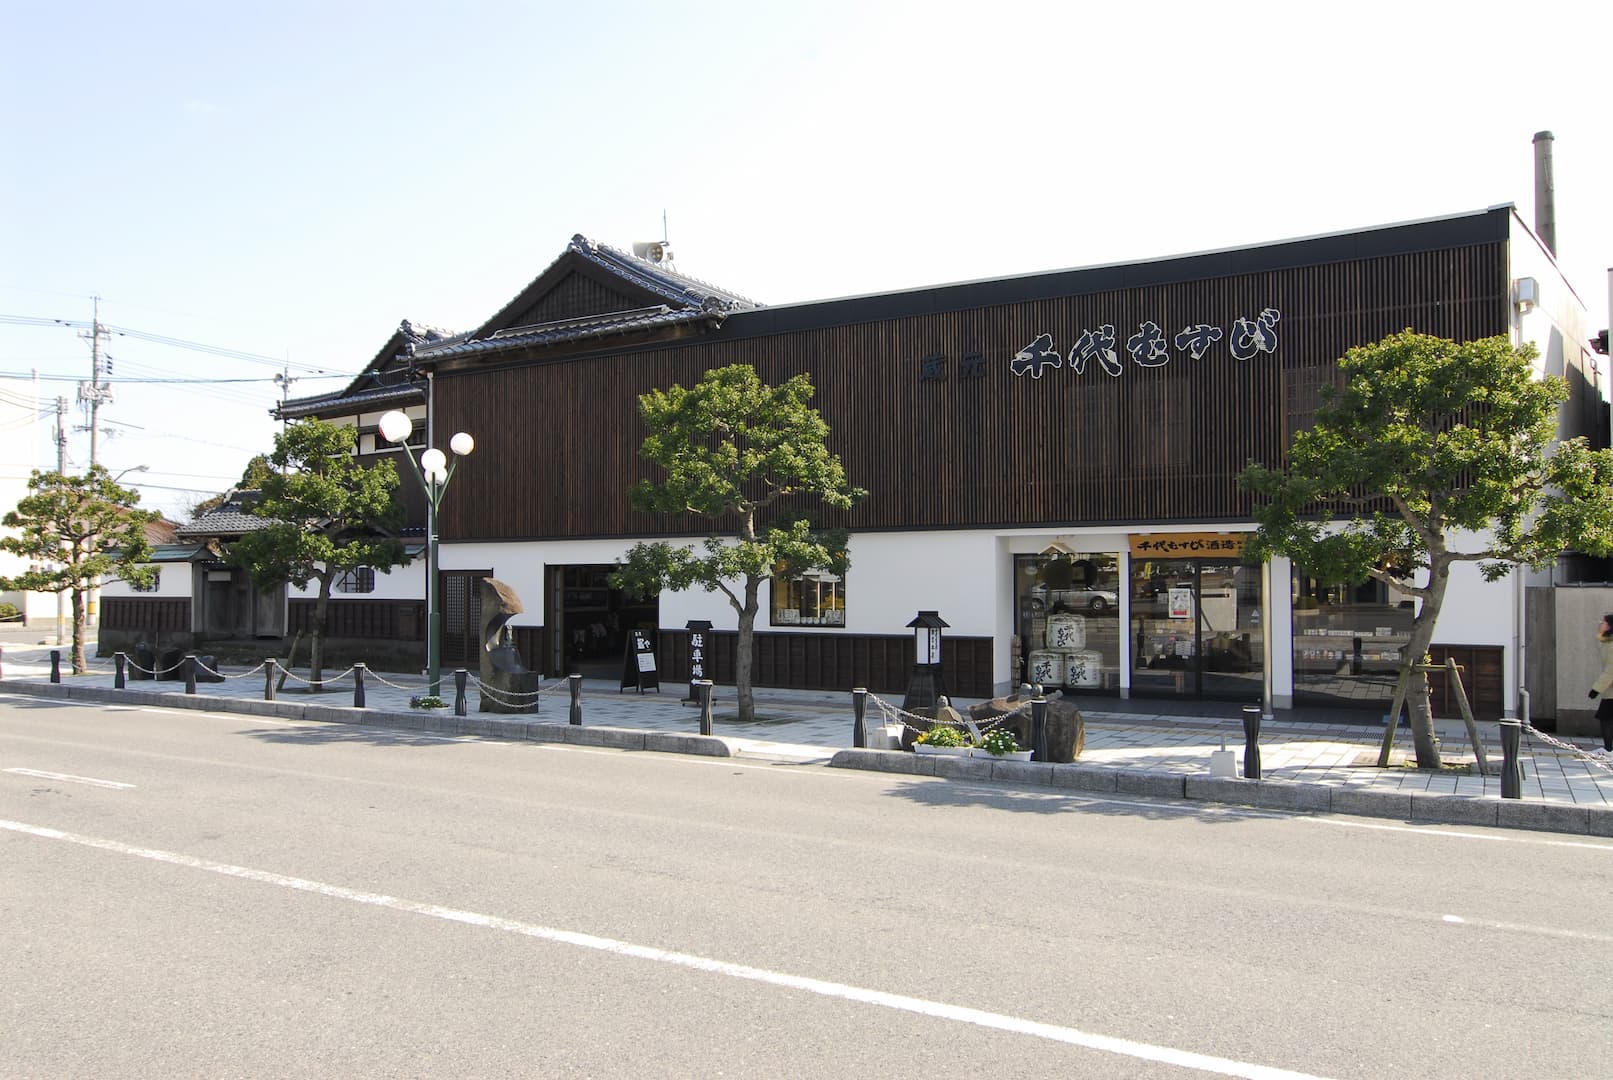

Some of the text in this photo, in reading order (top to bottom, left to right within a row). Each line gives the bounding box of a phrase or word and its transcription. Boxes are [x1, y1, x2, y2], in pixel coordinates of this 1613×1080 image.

[1010, 308, 1281, 379] 千代むすび
[691, 633, 703, 677] 駐車場
